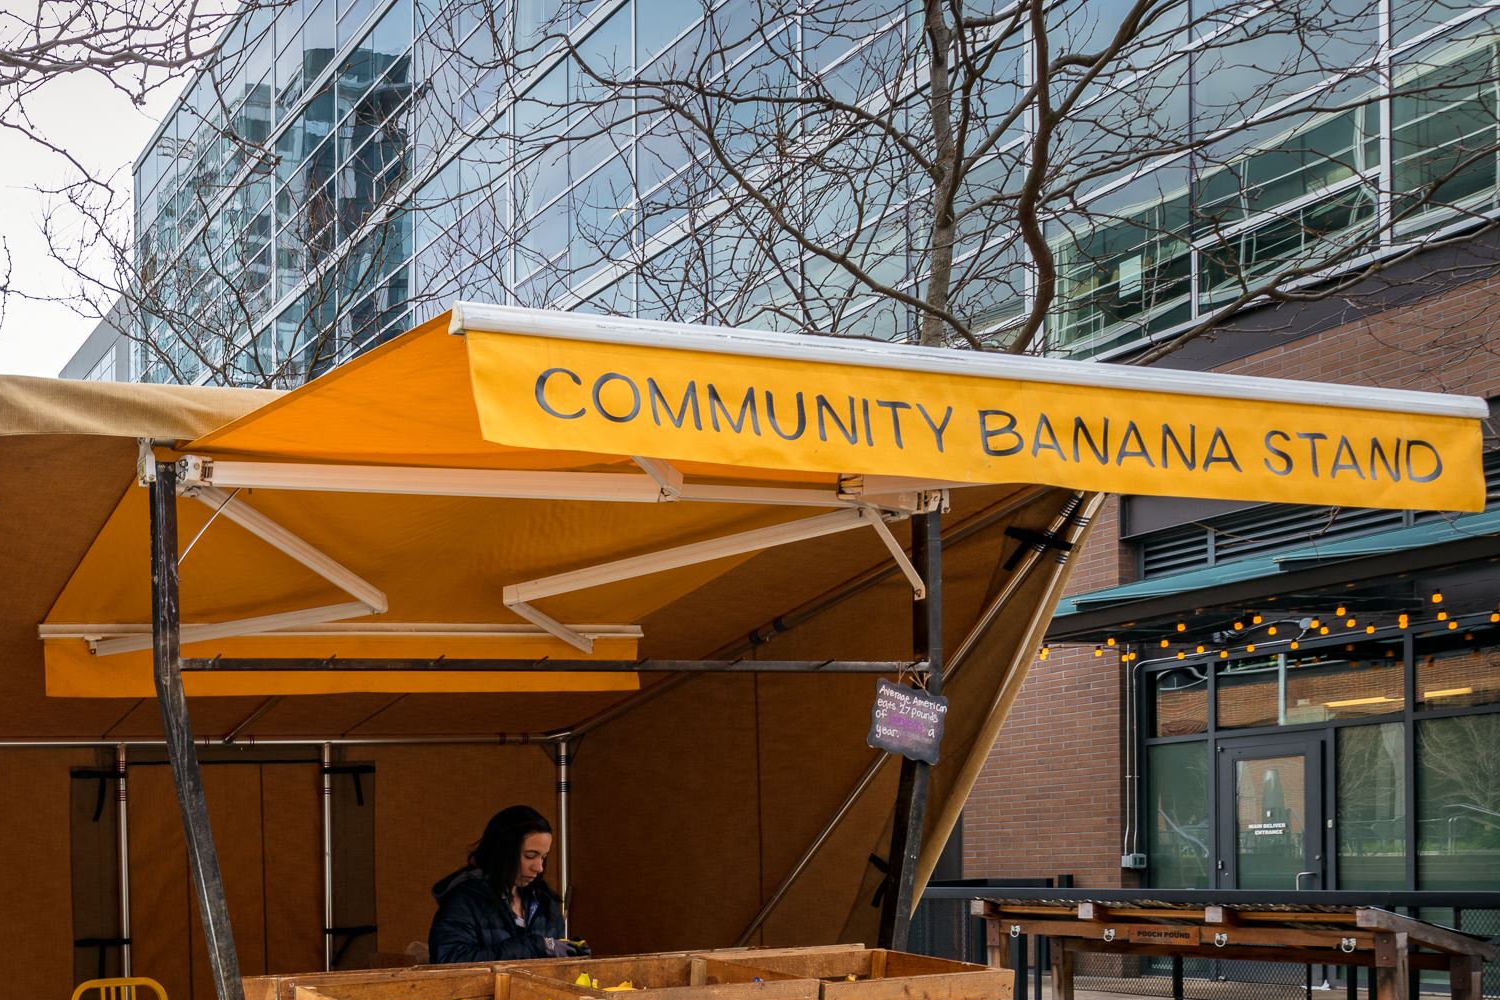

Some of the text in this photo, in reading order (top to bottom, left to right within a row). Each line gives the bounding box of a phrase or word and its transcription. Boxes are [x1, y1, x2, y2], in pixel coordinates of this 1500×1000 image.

[534, 367, 1443, 484] COMMUNITY BANANA STAND
[877, 698, 897, 711] eats
[879, 685, 947, 713] Average American
[875, 709, 935, 738] of a
[1137, 930, 1190, 939] POOCH POUND
